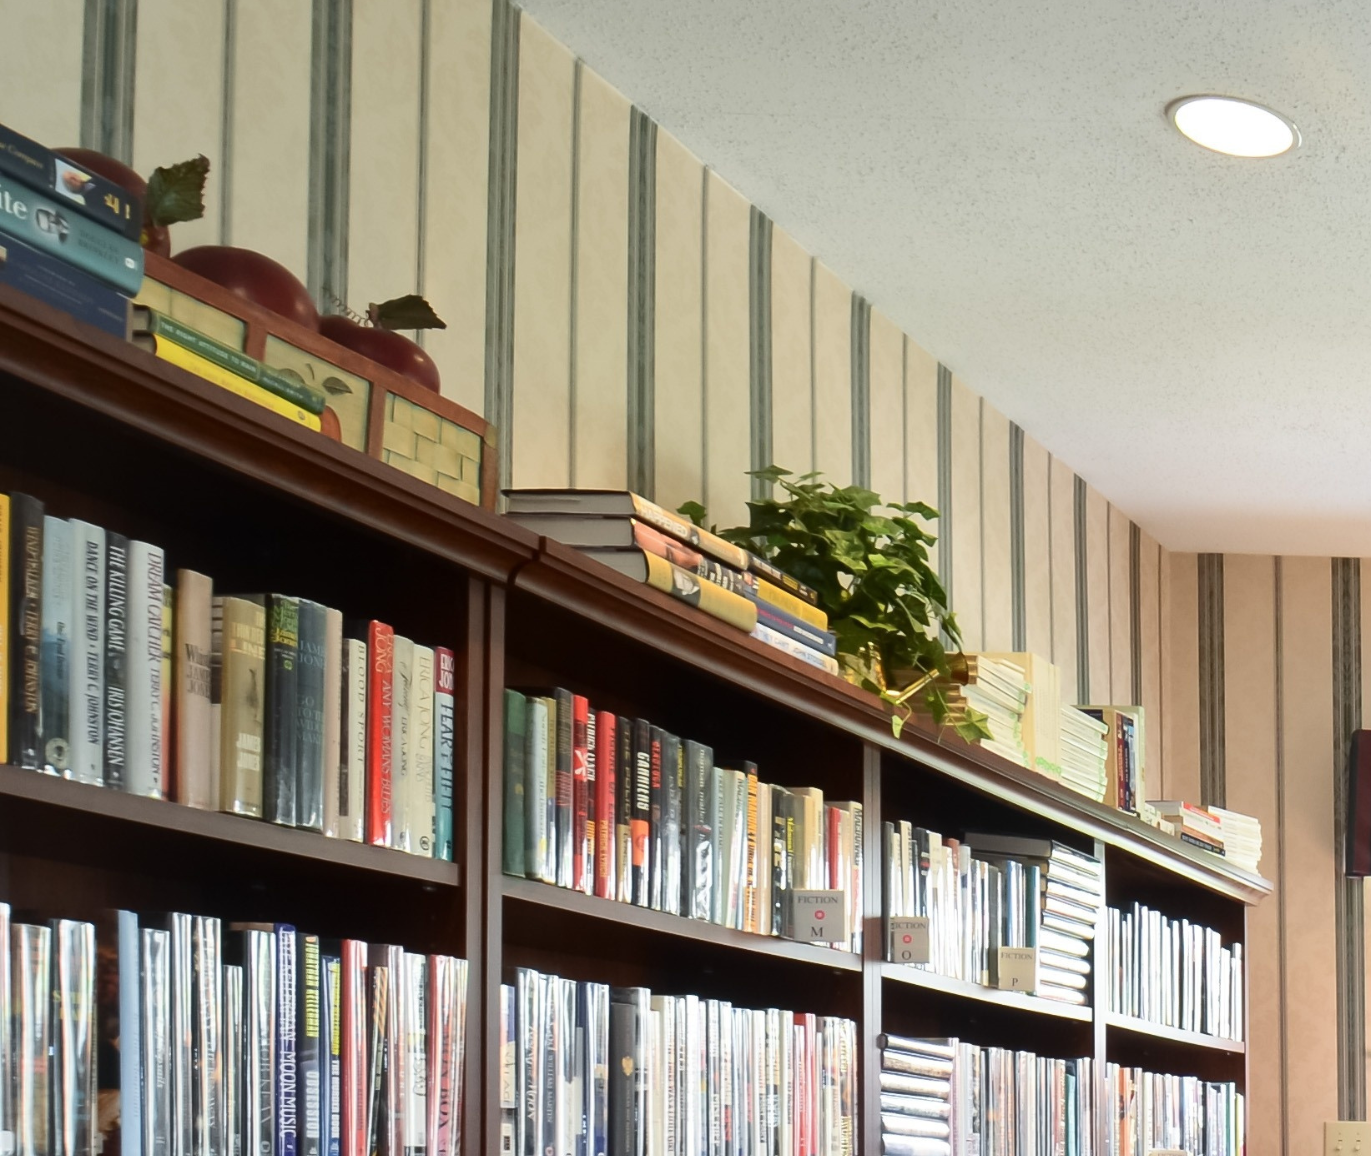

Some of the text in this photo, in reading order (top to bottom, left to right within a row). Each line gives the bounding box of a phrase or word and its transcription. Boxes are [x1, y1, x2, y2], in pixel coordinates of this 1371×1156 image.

[108, 547, 125, 569] THE
[108, 570, 125, 616] KILLING
[148, 553, 162, 664] DREAM CATCHER
[85, 541, 99, 746] DANCE THE WIND TERRY JOHNSTON
[108, 618, 125, 657] GAME
[375, 628, 387, 674] JONG
[108, 686, 125, 709] IRIS
[356, 645, 365, 764] BLOOD SPORT
[417, 656, 431, 750] ERICA JONG
[108, 708, 125, 767] JOHANSEN
[440, 703, 454, 811] FEAR FIFTY
[797, 895, 839, 905] FICTION
[810, 926, 824, 938] M
[901, 950, 912, 961] O
[1000, 952, 1033, 961] FICTION
[1012, 977, 1019, 987] P
[280, 1050, 297, 1140] MOON MUSIC
[306, 1070, 320, 1139] OBSESSION
